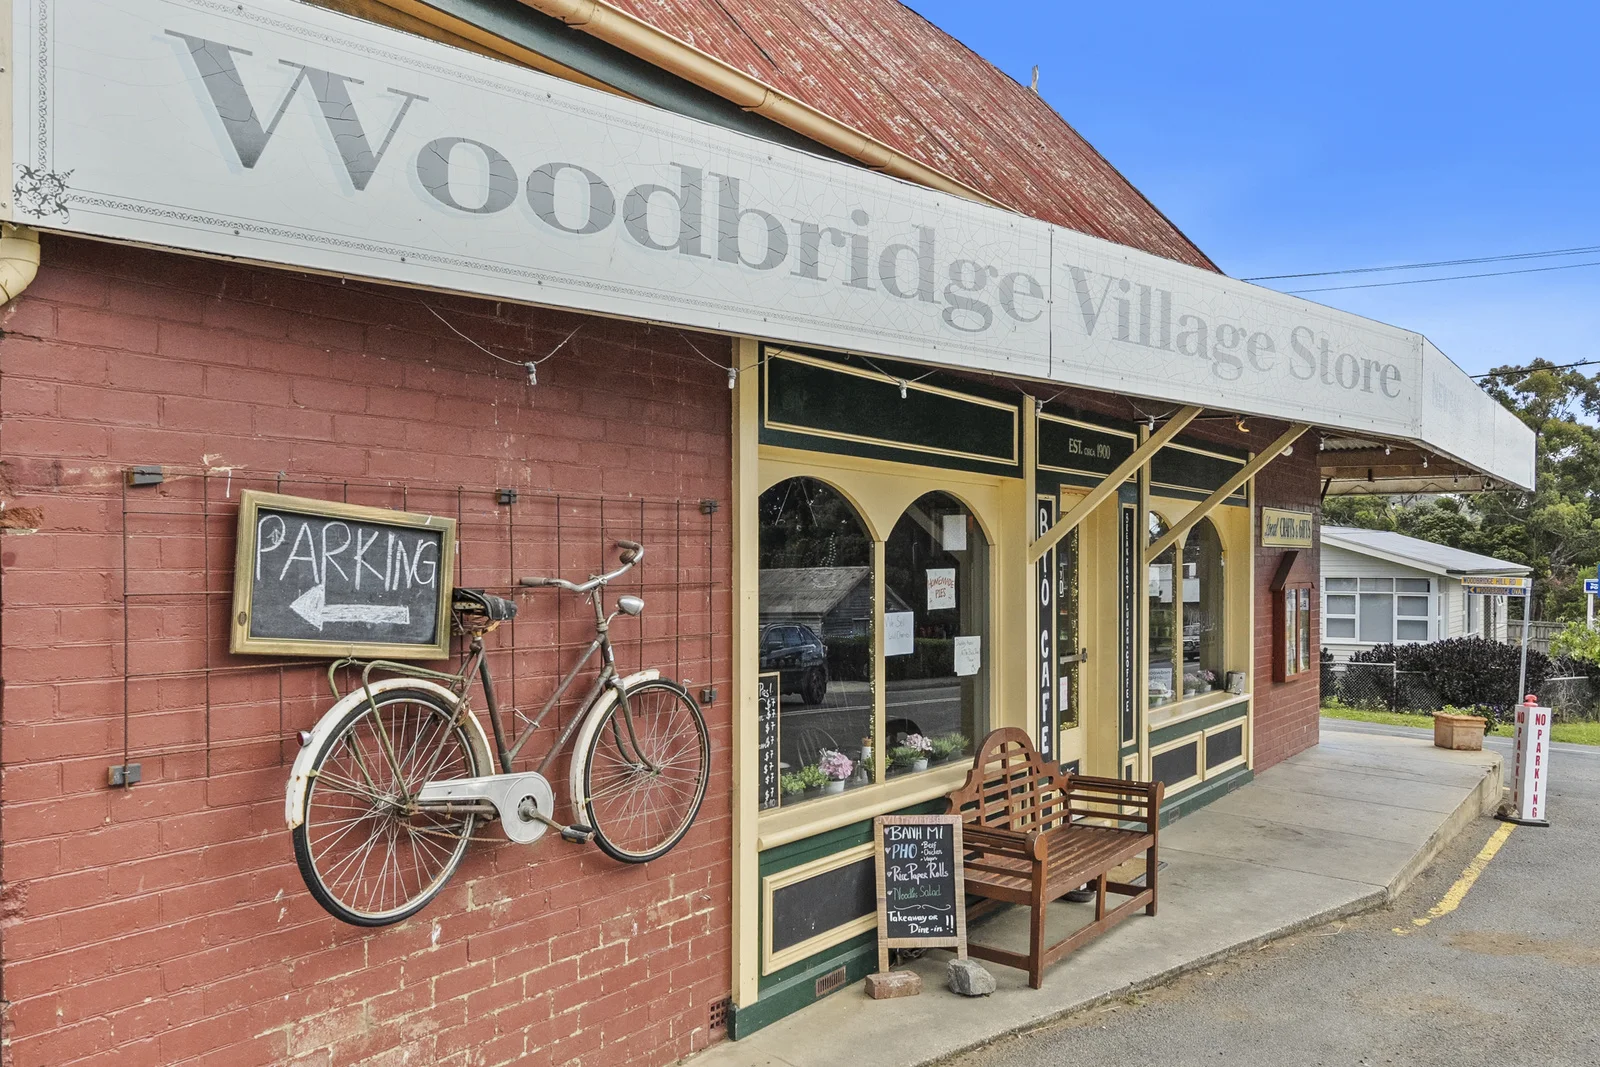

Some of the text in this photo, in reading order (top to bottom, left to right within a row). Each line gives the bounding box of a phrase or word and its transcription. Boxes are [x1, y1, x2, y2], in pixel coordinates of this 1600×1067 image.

[164, 29, 1044, 332] Woodbridge
[1063, 263, 1276, 382] Village
[1290, 325, 1402, 399] Store
[1068, 437, 1083, 455] EST.
[1096, 443, 1111, 460] 1900
[256, 514, 438, 591] PARKING
[1463, 576, 1494, 585] WOODBRIDGE
[935, 587, 947, 599] PIES
[1476, 587, 1524, 595] WOODBRIDGE OVAL
[1041, 629, 1050, 755] CAFE
[1517, 711, 1525, 723] NO
[1535, 713, 1546, 726] NO
[1531, 729, 1543, 818] PARKING
[889, 825, 922, 841] BANH
[891, 843, 918, 860] PHO
[890, 861, 949, 885] Rice Paper Rolls
[919, 884, 942, 897] Salad
[887, 911, 928, 923] Takeaway
[908, 923, 943, 934] Dine-in
